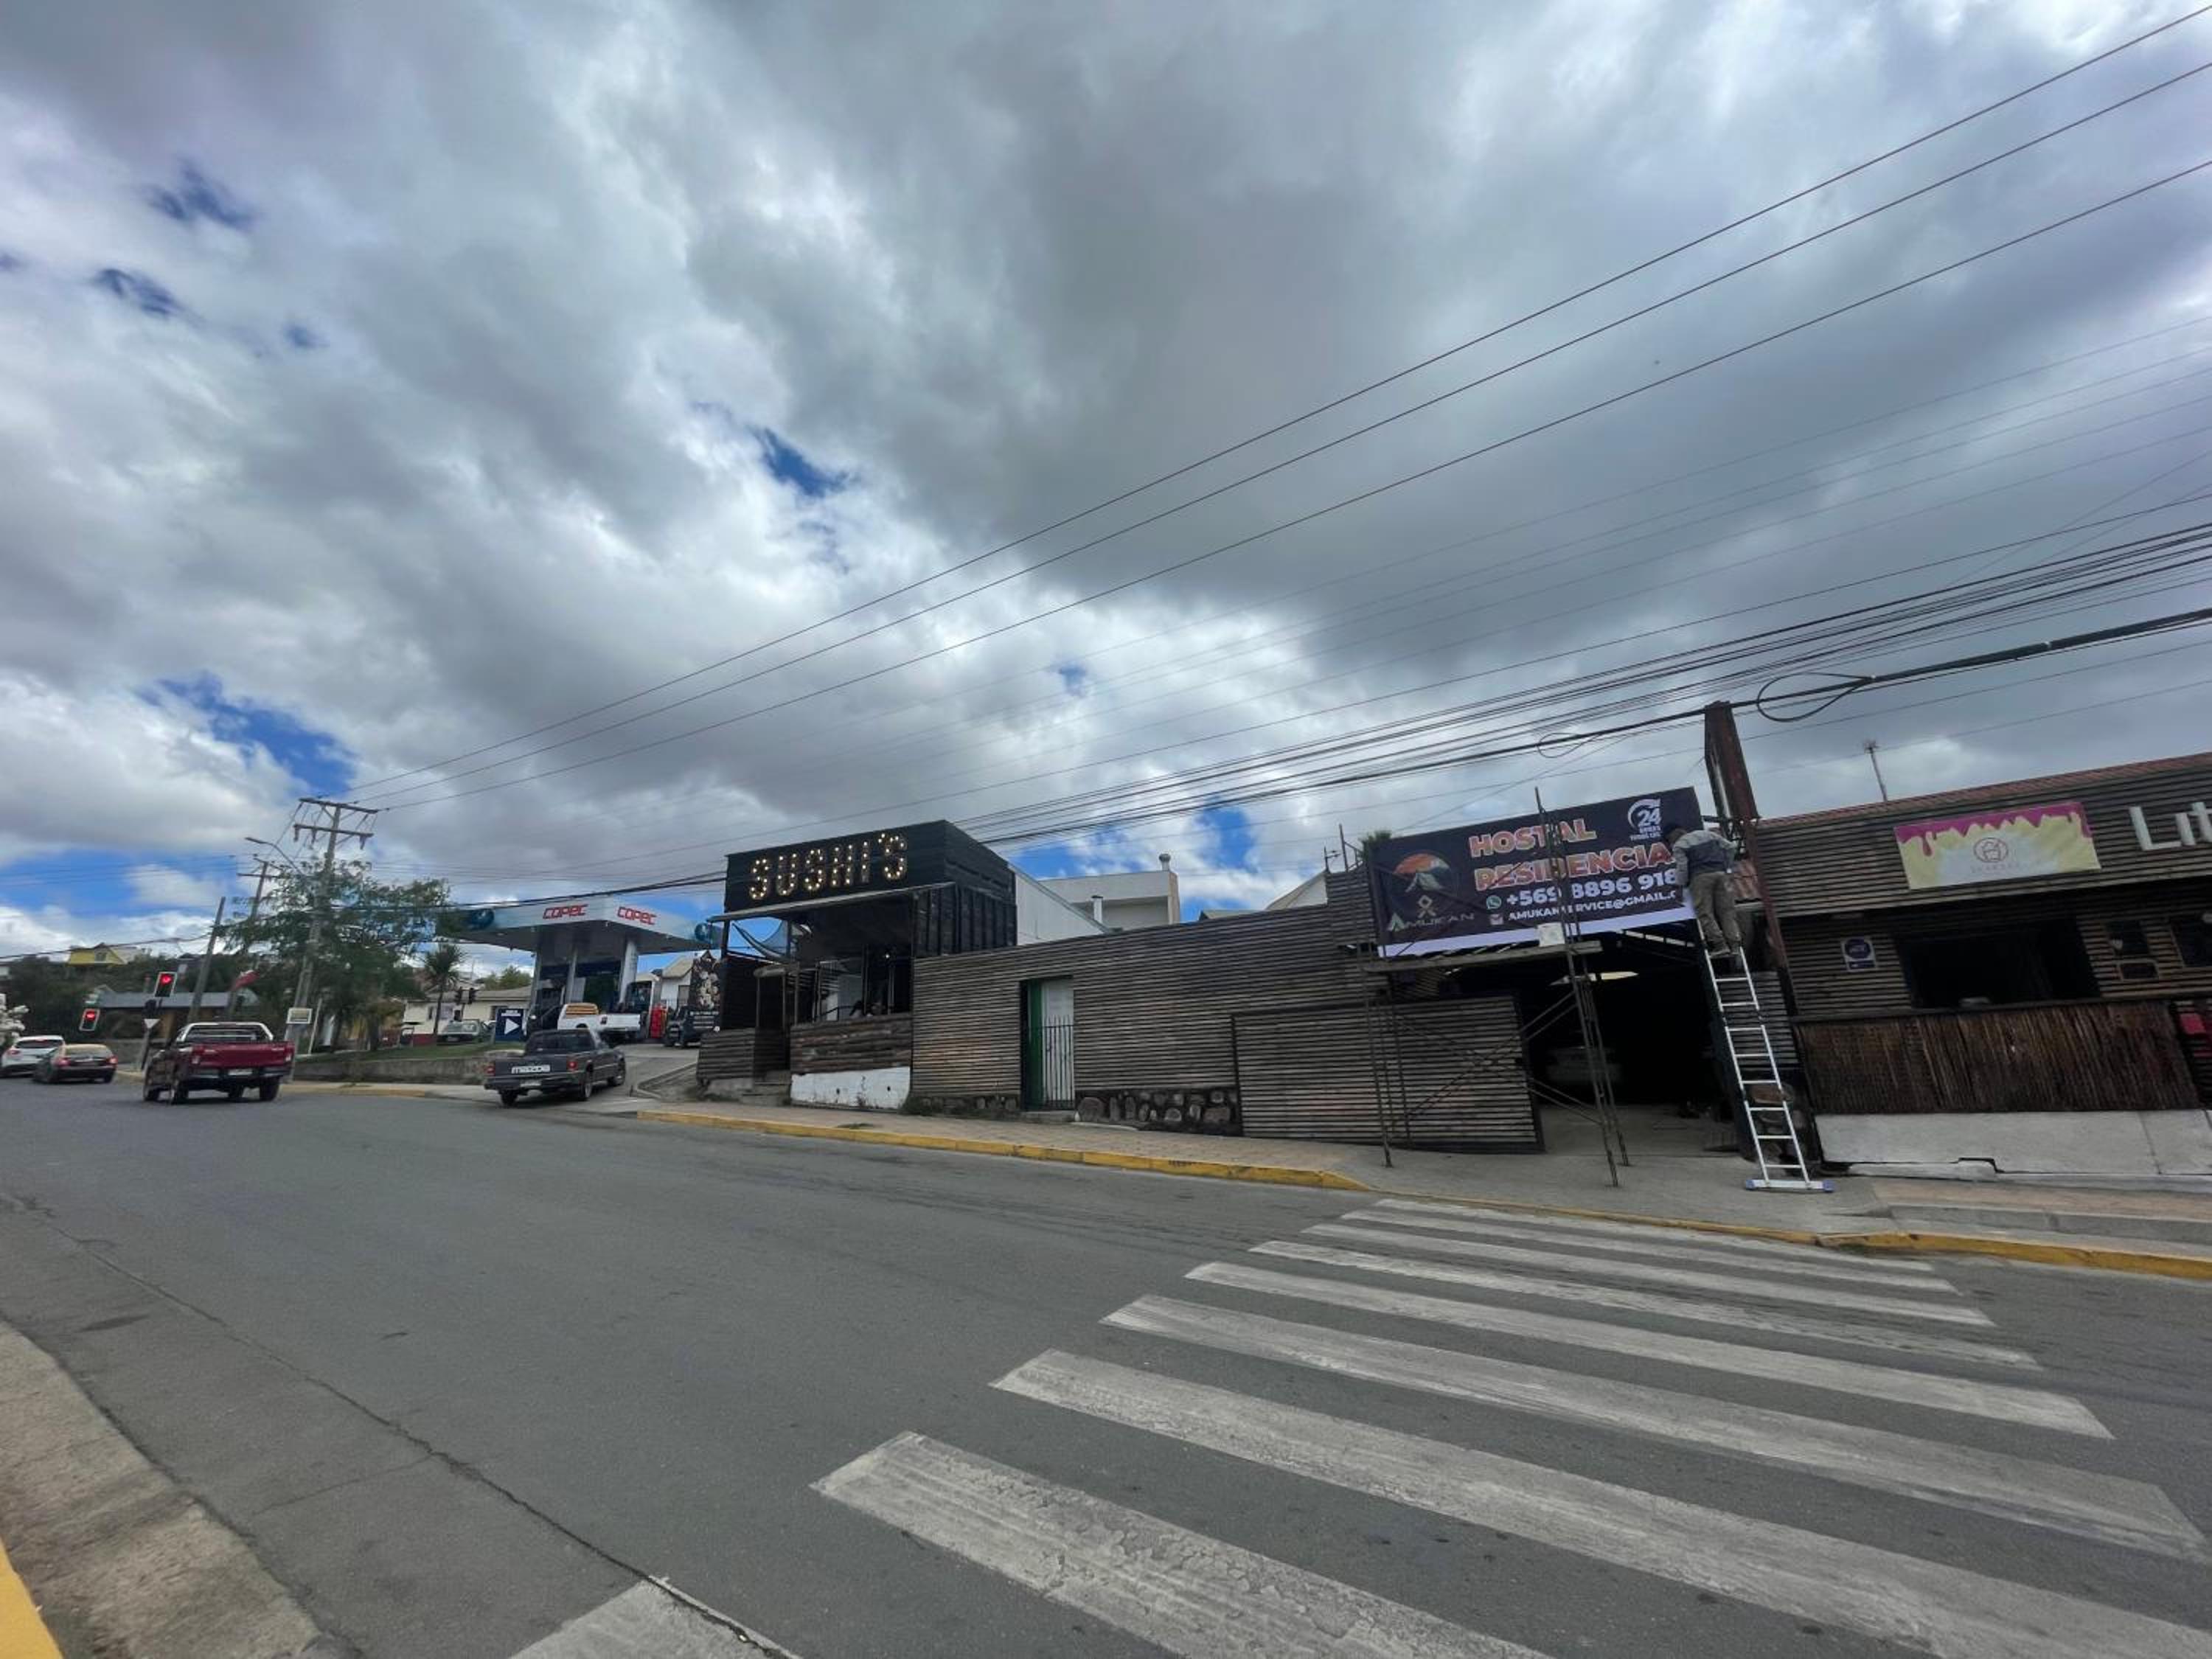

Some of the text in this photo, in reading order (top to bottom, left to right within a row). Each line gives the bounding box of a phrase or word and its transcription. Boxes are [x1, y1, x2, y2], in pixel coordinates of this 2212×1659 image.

[1638, 807, 1661, 827] 24
[1469, 818, 1597, 858] HOSTAL
[748, 832, 908, 900] SUSHI'S
[1572, 877, 1632, 899] 8896
[543, 904, 588, 919] COPEC
[618, 906, 657, 925] COPEC
